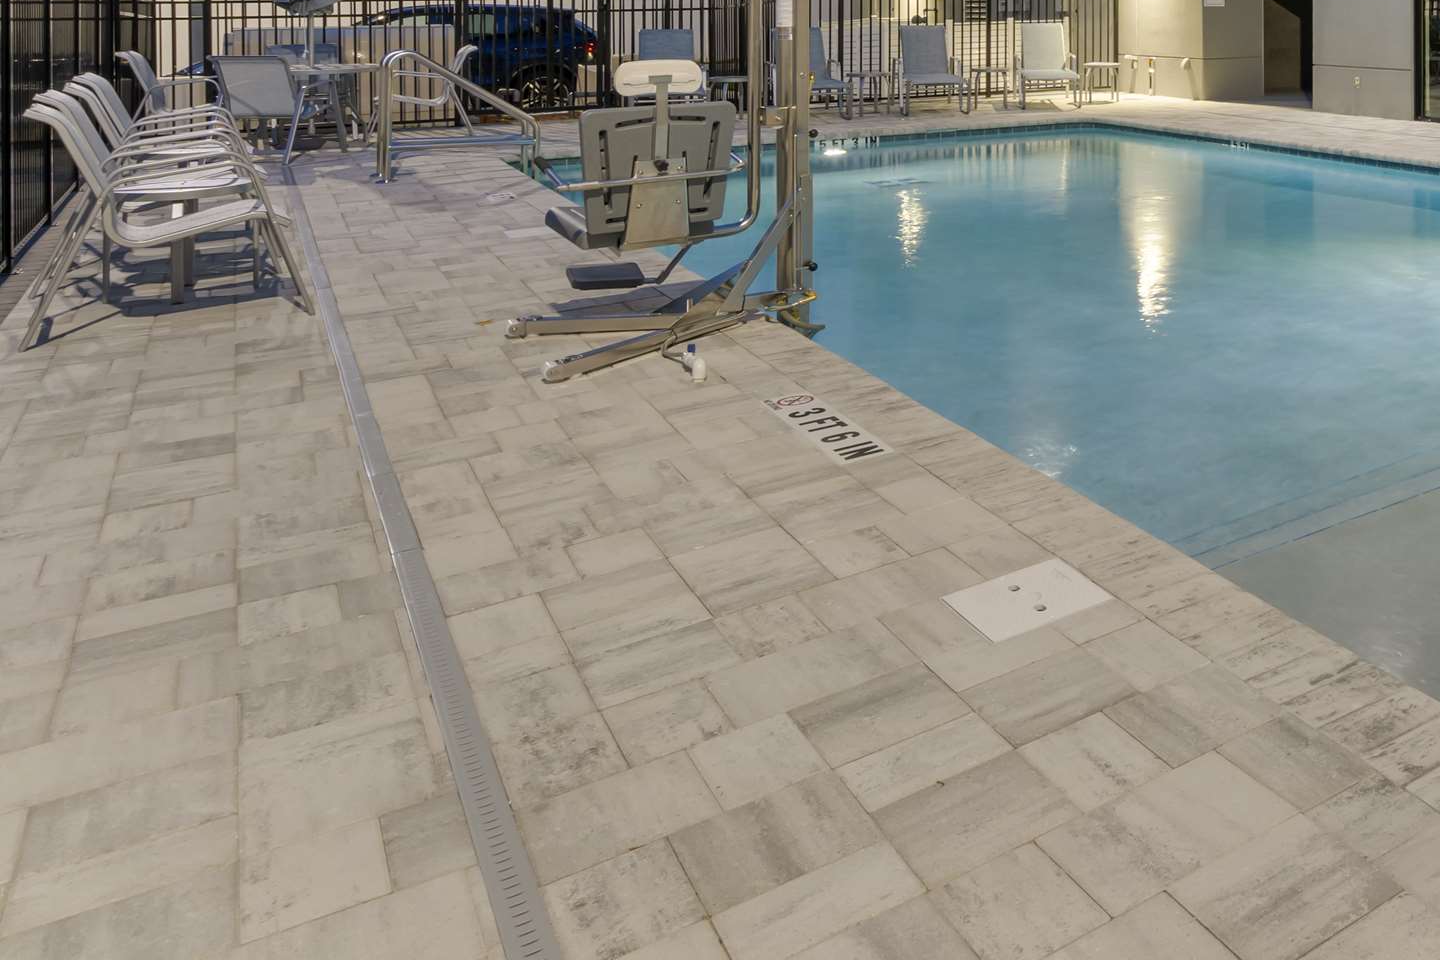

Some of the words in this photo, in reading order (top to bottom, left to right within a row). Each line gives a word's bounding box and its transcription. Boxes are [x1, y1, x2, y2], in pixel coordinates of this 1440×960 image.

[865, 135, 877, 144] IN
[788, 407, 827, 418] 3
[798, 415, 849, 432] FT
[821, 431, 861, 444] 6
[833, 440, 885, 461] IN
